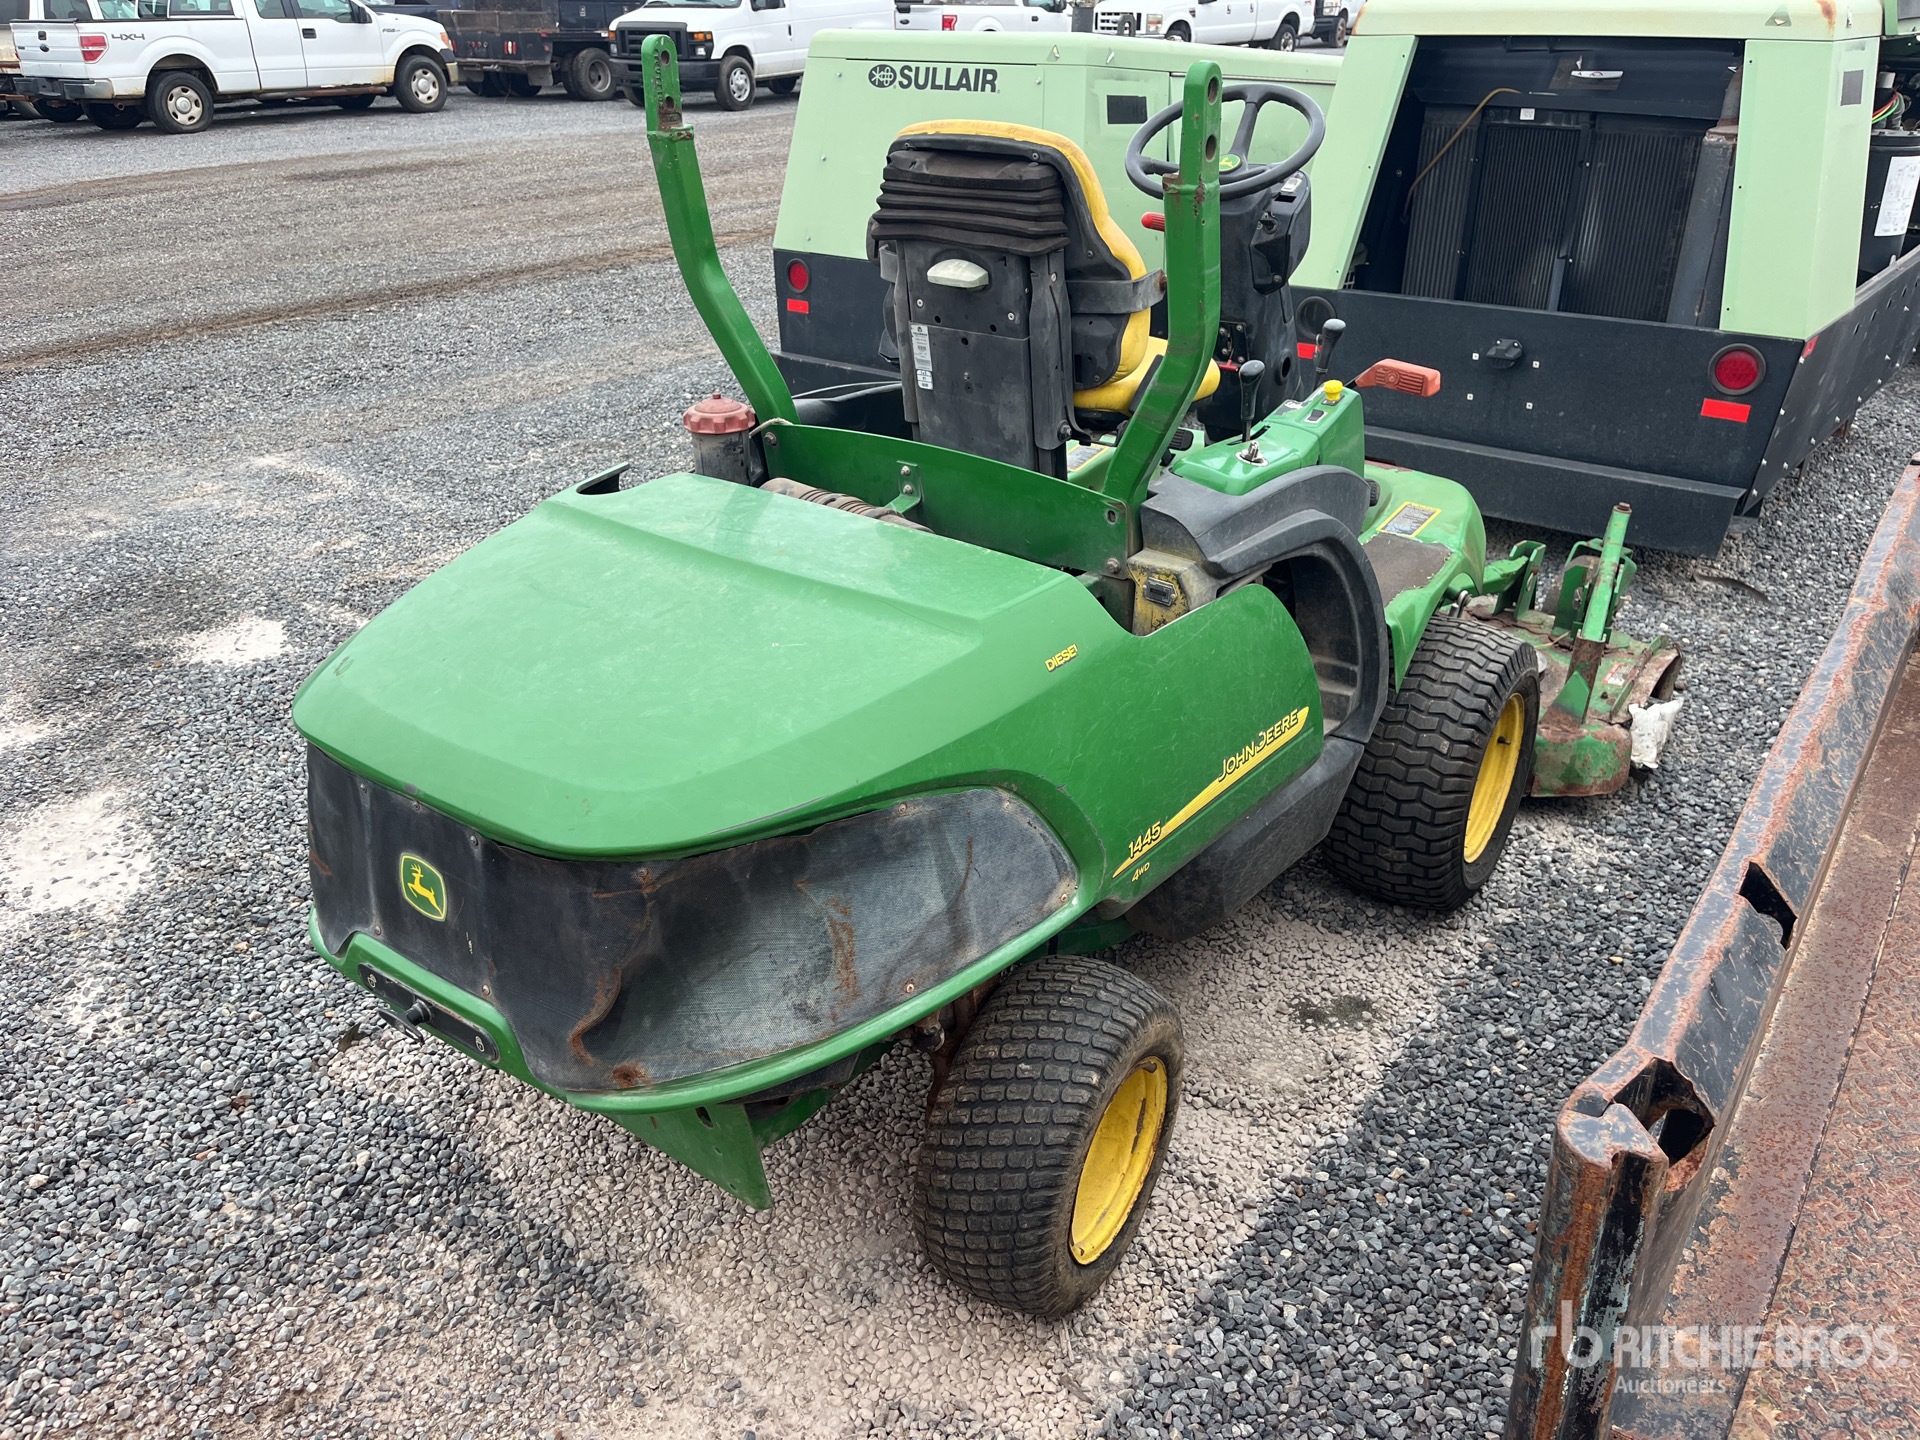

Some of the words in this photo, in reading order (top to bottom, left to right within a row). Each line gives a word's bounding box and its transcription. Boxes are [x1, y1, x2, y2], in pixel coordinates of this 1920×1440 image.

[898, 64, 998, 93] SULLAIR
[1218, 740, 1255, 783] JOHN
[1256, 708, 1299, 754] DEERE
[1128, 820, 1161, 859] 1445
[1131, 862, 1150, 882] 4WD
